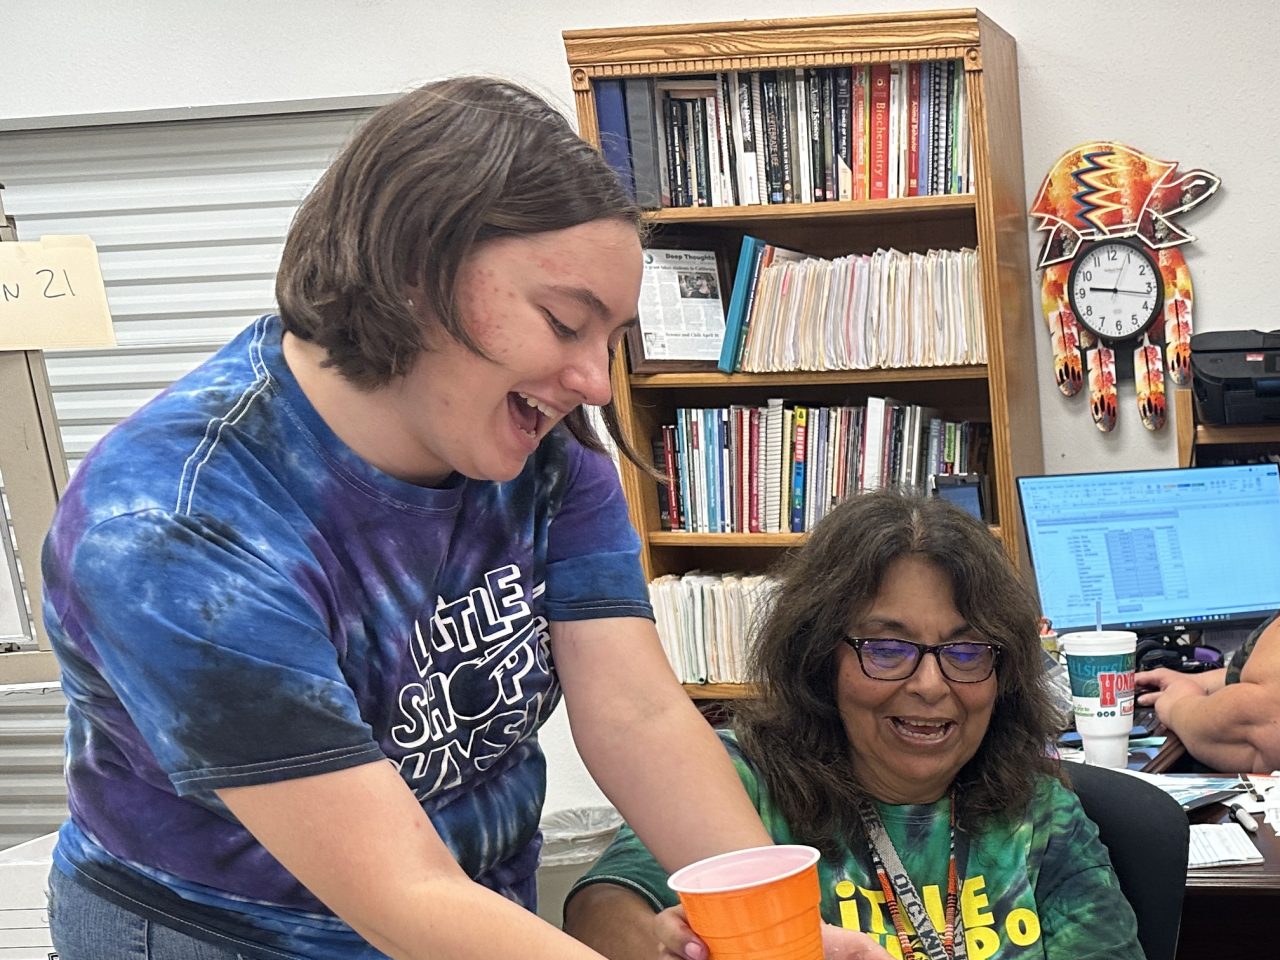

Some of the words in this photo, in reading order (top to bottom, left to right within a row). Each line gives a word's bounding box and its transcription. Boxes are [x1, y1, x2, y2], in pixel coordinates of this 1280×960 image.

[875, 102, 886, 175] Biochemistry
[685, 253, 715, 261] Thoughts
[1107, 250, 1117, 260] 12
[1127, 253, 1131, 264] 1
[1093, 256, 1101, 267] 11
[1082, 271, 1092, 281] 10
[1139, 265, 1146, 276] 2
[36, 268, 75, 298] 21
[1146, 283, 1153, 294] 3
[1079, 288, 1086, 299] 9
[1086, 305, 1093, 316] 8
[1142, 301, 1149, 311] 4
[1099, 317, 1105, 327] 7
[1131, 314, 1138, 325] 5
[1115, 320, 1122, 331] 6
